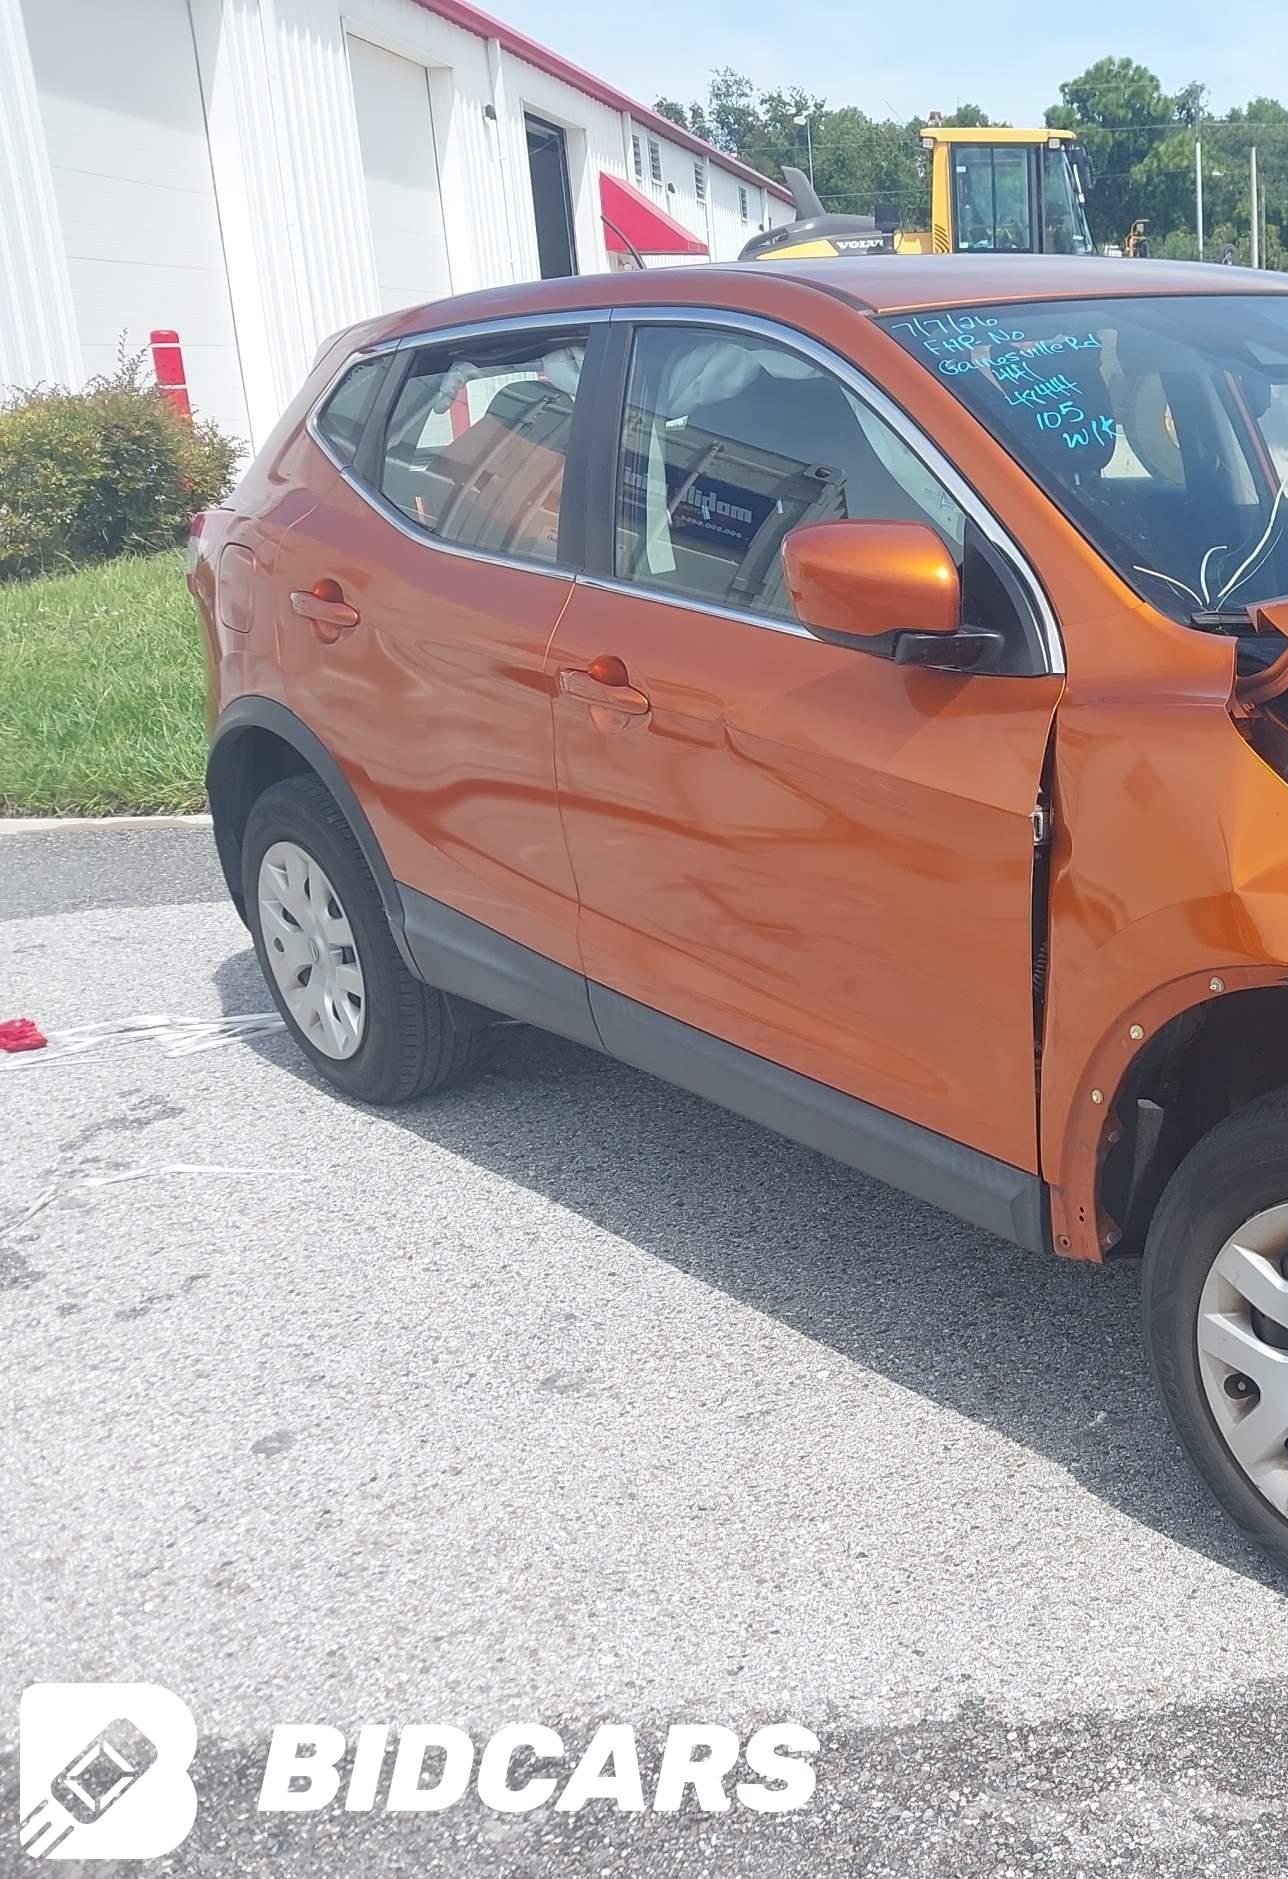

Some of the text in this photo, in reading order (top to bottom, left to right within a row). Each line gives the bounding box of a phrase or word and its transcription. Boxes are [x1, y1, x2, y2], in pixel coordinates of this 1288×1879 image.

[836, 239, 884, 250] VOLV
[891, 314, 998, 337] 7/7/26
[938, 333, 1103, 375] Gainesville Rd
[1036, 401, 1084, 430] 105
